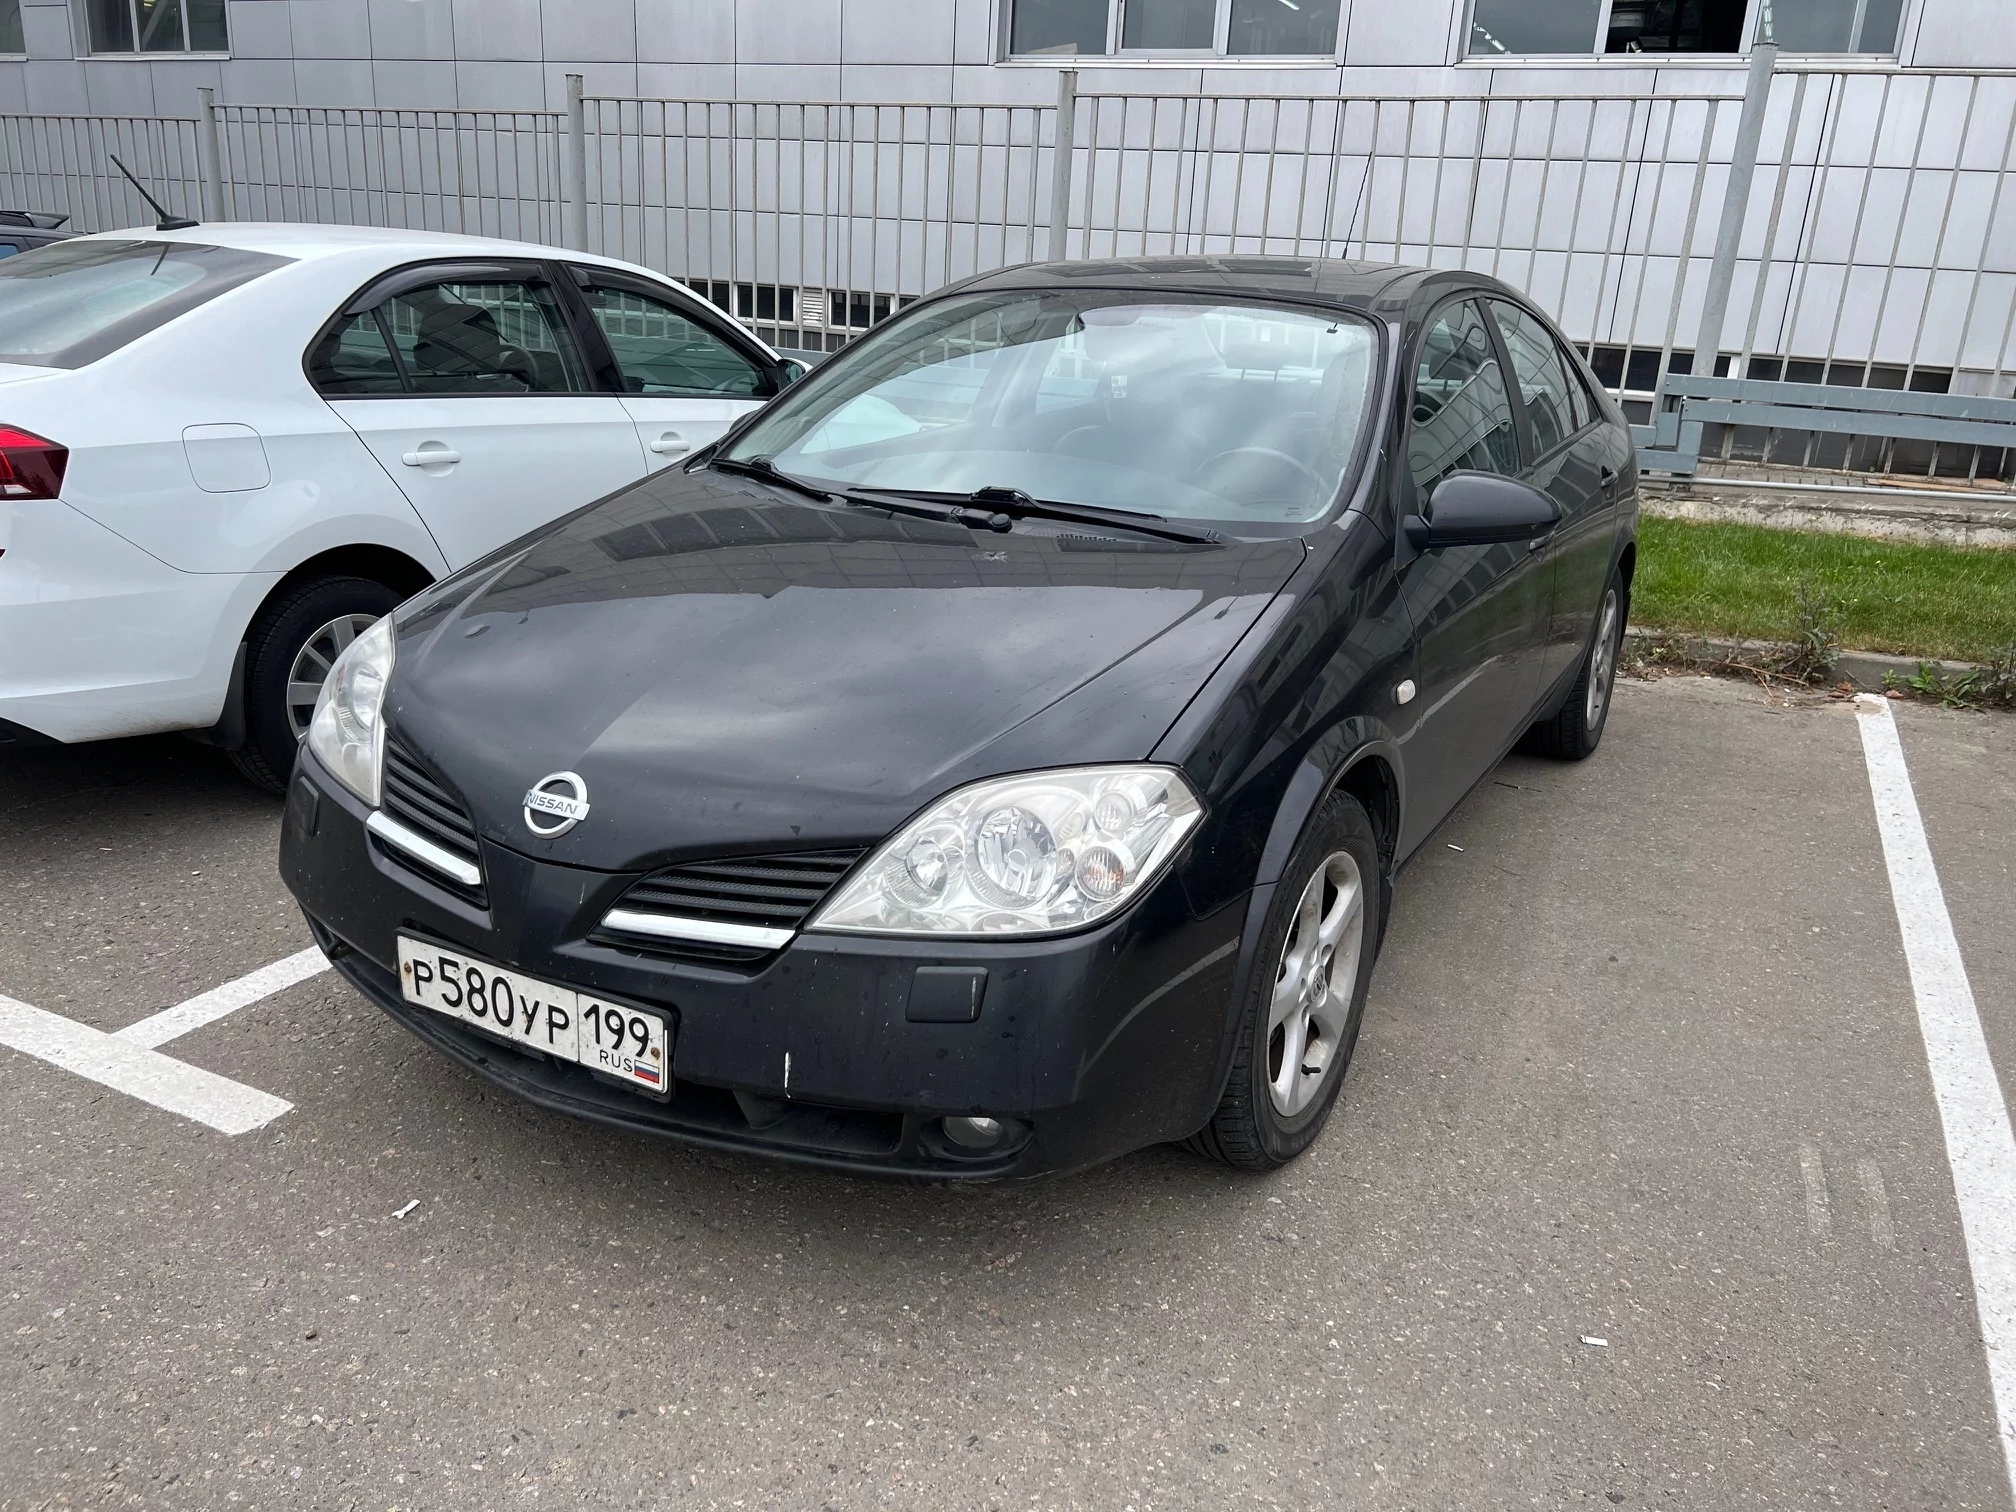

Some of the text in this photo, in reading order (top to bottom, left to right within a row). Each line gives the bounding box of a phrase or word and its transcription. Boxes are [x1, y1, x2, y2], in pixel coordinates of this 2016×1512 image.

[526, 792, 579, 815] NISSAN
[583, 1003, 650, 1058] 199
[599, 1049, 633, 1073] RUS
